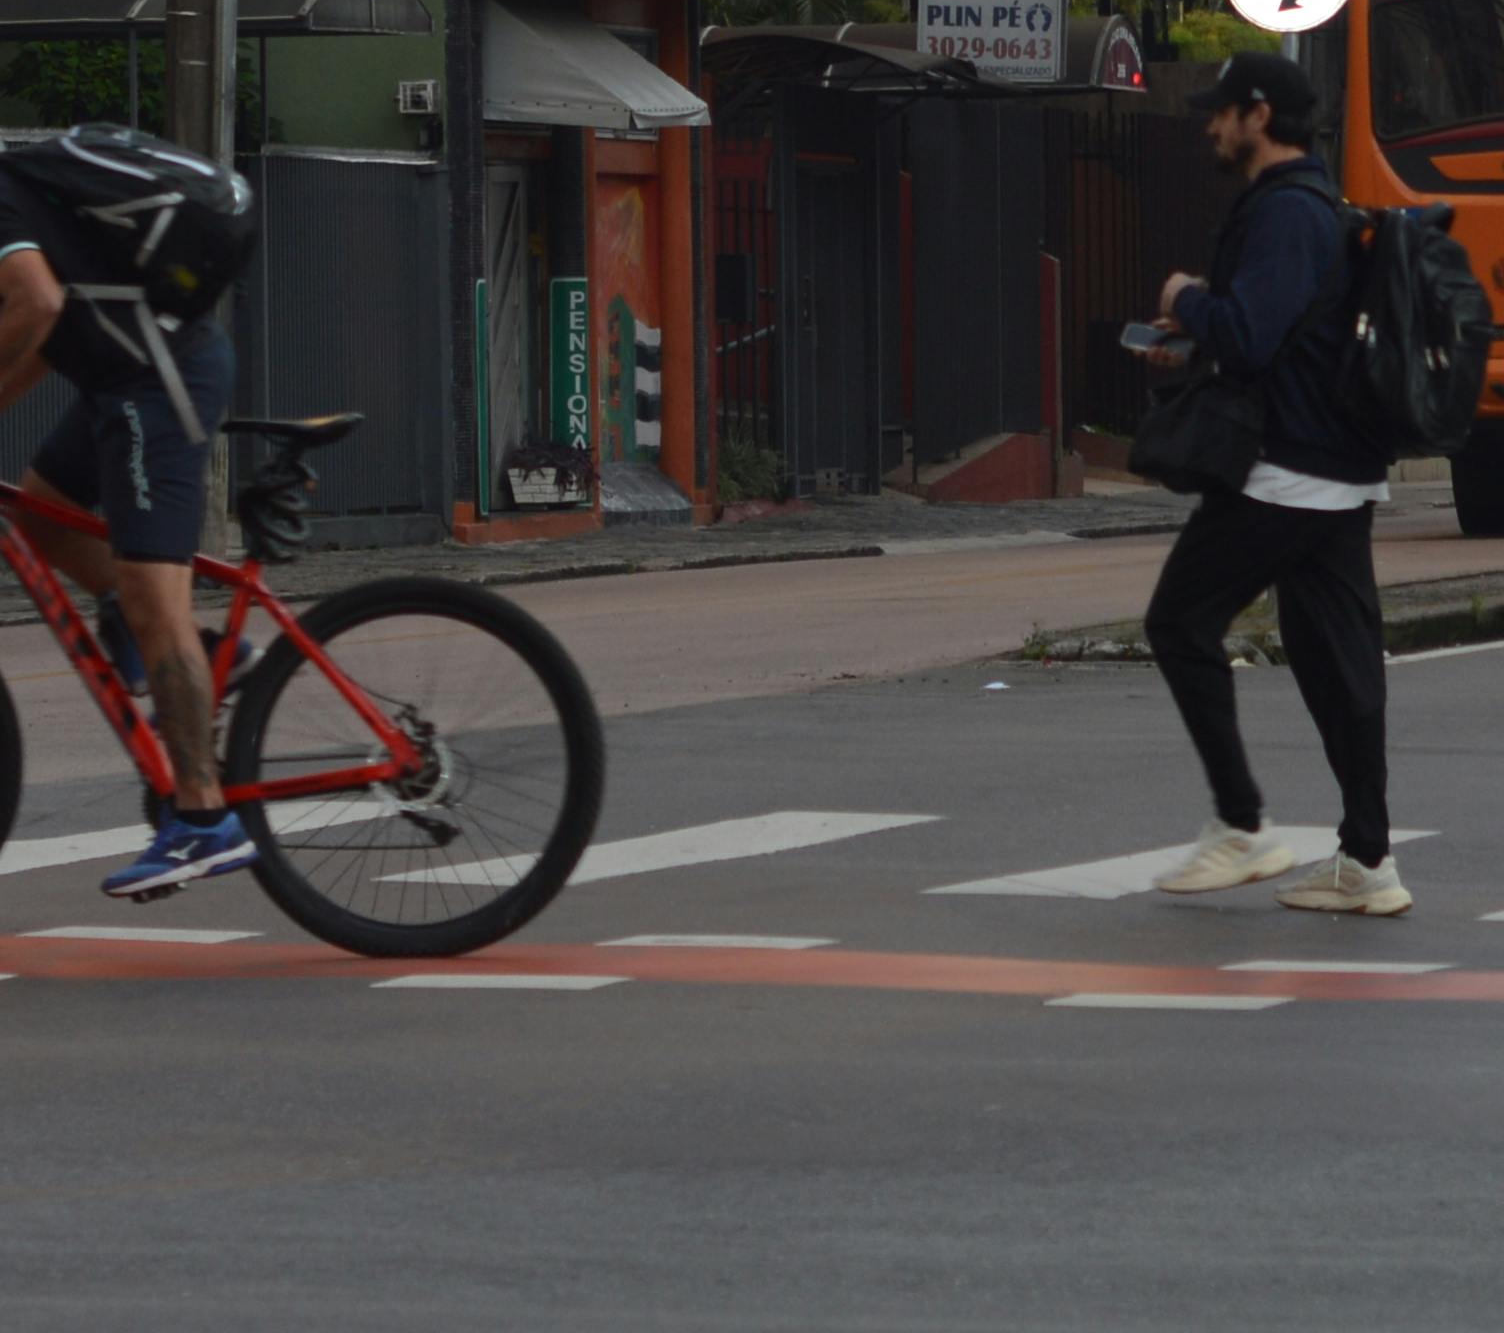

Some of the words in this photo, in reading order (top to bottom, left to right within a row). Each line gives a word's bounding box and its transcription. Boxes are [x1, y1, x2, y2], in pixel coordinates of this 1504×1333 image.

[927, 4, 982, 28] PLIN
[992, 0, 1021, 28] PÉ
[926, 36, 1052, 60] 3029-0643
